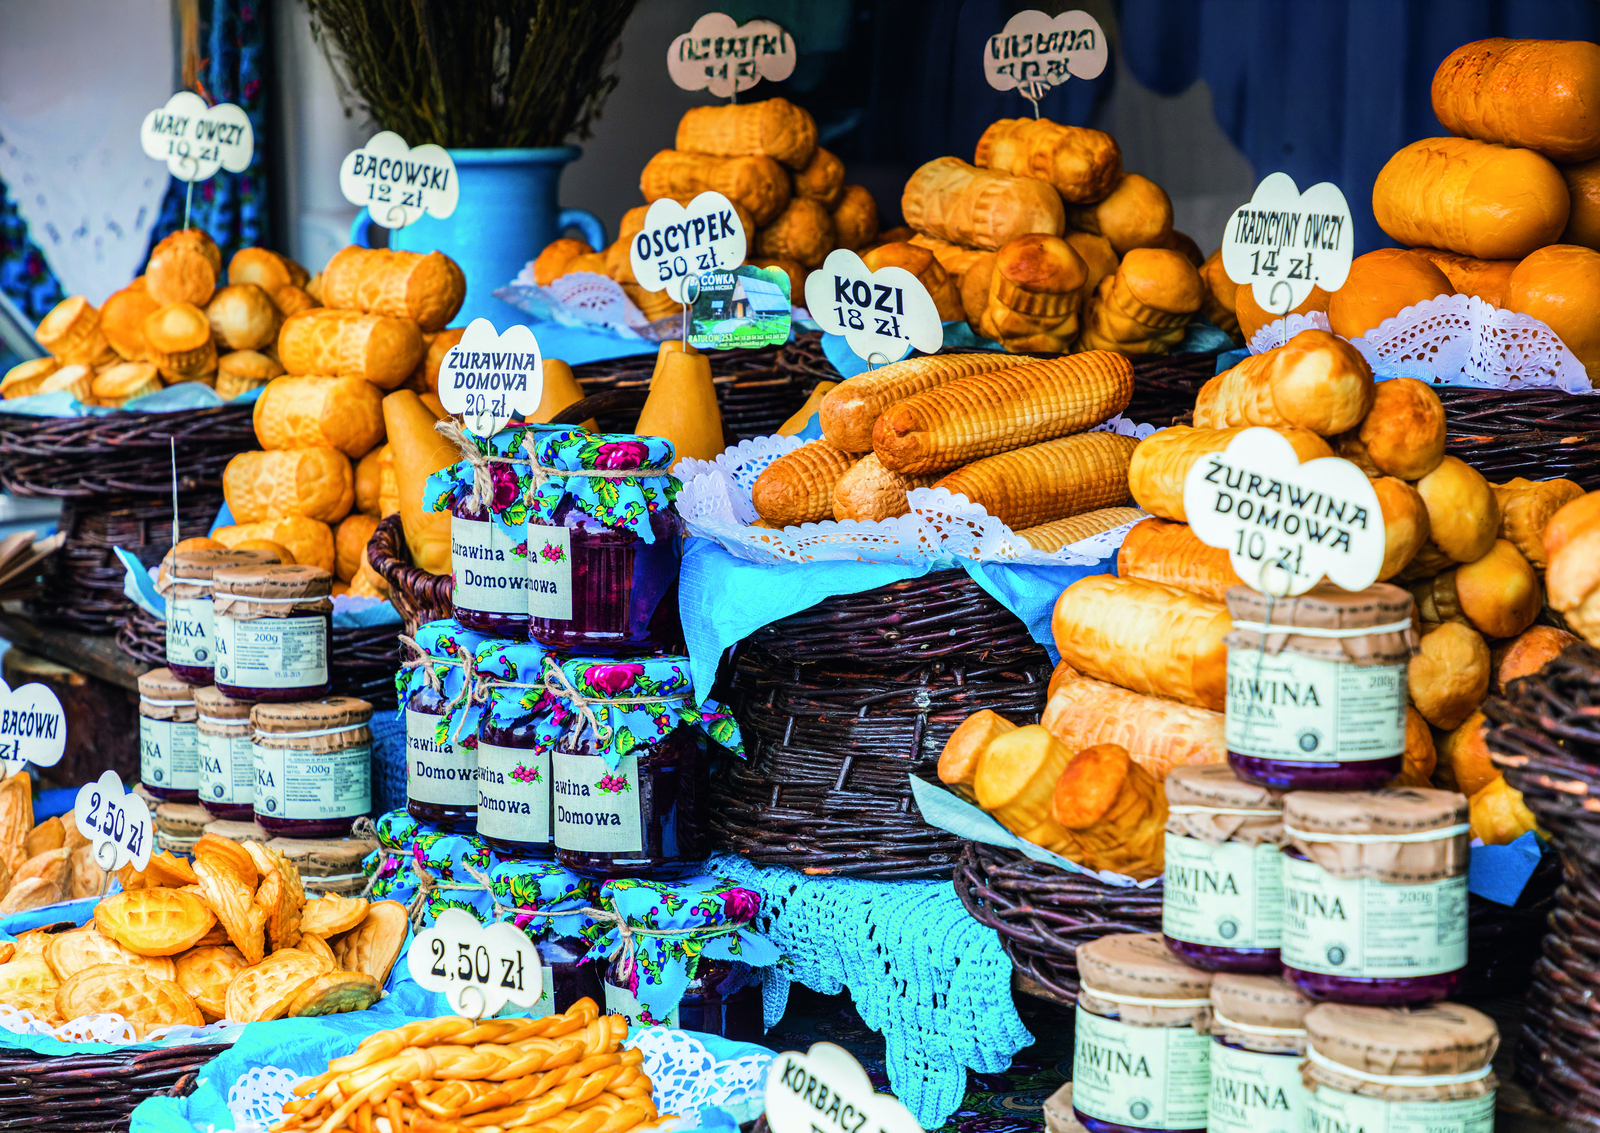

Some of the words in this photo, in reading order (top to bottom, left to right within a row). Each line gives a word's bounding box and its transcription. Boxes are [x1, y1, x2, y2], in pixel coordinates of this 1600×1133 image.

[151, 112, 188, 138] MAŁY
[195, 119, 247, 147] OWCZY
[352, 153, 449, 192] BACOWSKI
[367, 183, 391, 203] 12
[636, 208, 737, 261] OSCYPEK
[1235, 209, 1301, 255] TRADYCYJNY
[1304, 213, 1344, 250] OWCZY
[658, 256, 689, 283] 50
[696, 246, 725, 271] zł.
[1251, 250, 1279, 277] 14
[1287, 252, 1319, 281] zł.
[833, 275, 905, 316] KOZI
[721, 333, 733, 342] 253
[833, 306, 865, 331] 18
[874, 315, 911, 342] zł.
[448, 347, 535, 371] ŻURAWINA
[453, 371, 527, 391] DOMOWA
[465, 393, 486, 416] 20
[1204, 454, 1368, 530] ŻURAWINA
[1214, 491, 1351, 553] DOMOWA
[1236, 529, 1266, 561] 10
[254, 632, 278, 645] 200g
[1, 703, 60, 739] BACÓWKI
[305, 765, 330, 776] 200g
[86, 792, 124, 843] 2,50
[127, 820, 144, 857] zł
[558, 805, 621, 826] Domowa
[431, 938, 490, 984] 2,50
[500, 950, 524, 991] zł
[780, 1058, 867, 1133] KORBACZ
